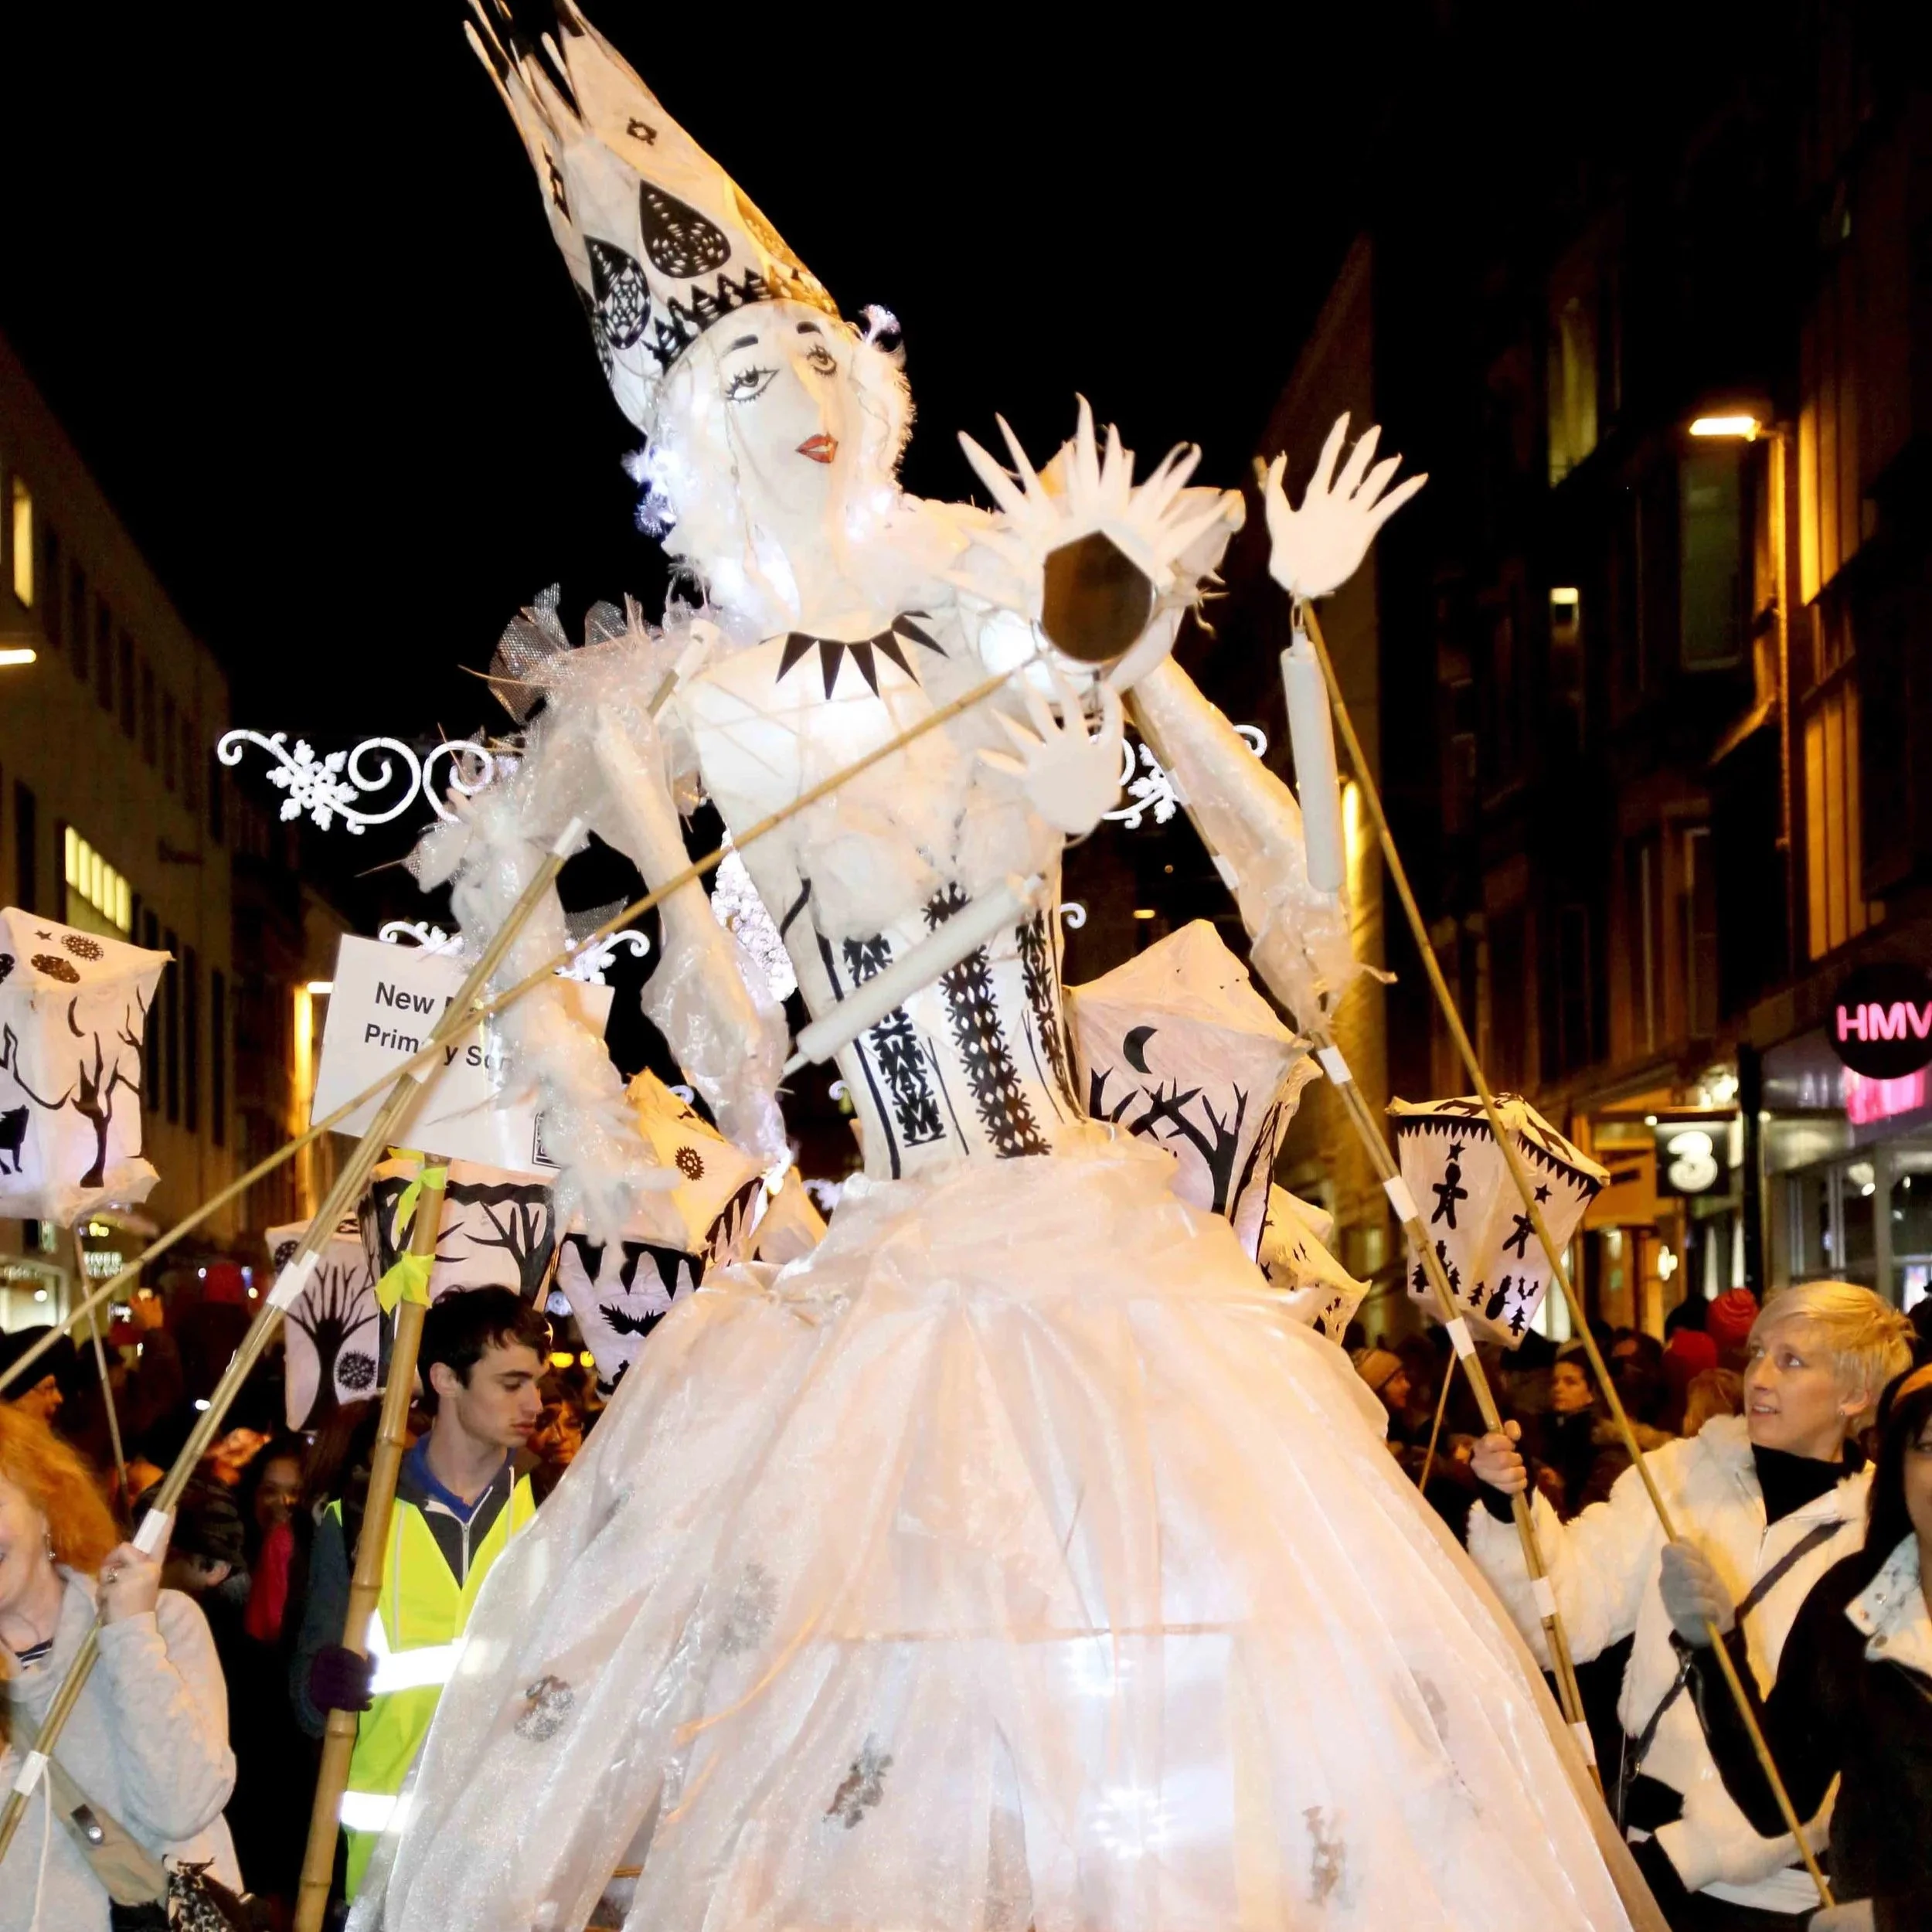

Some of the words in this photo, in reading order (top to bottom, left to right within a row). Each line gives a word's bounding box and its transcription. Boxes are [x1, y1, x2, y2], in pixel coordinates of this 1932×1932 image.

[375, 981, 434, 1015] New
[1836, 1001, 1932, 1042] HMV
[364, 1023, 459, 1066] Primy
[1667, 1130, 1718, 1193] 3
